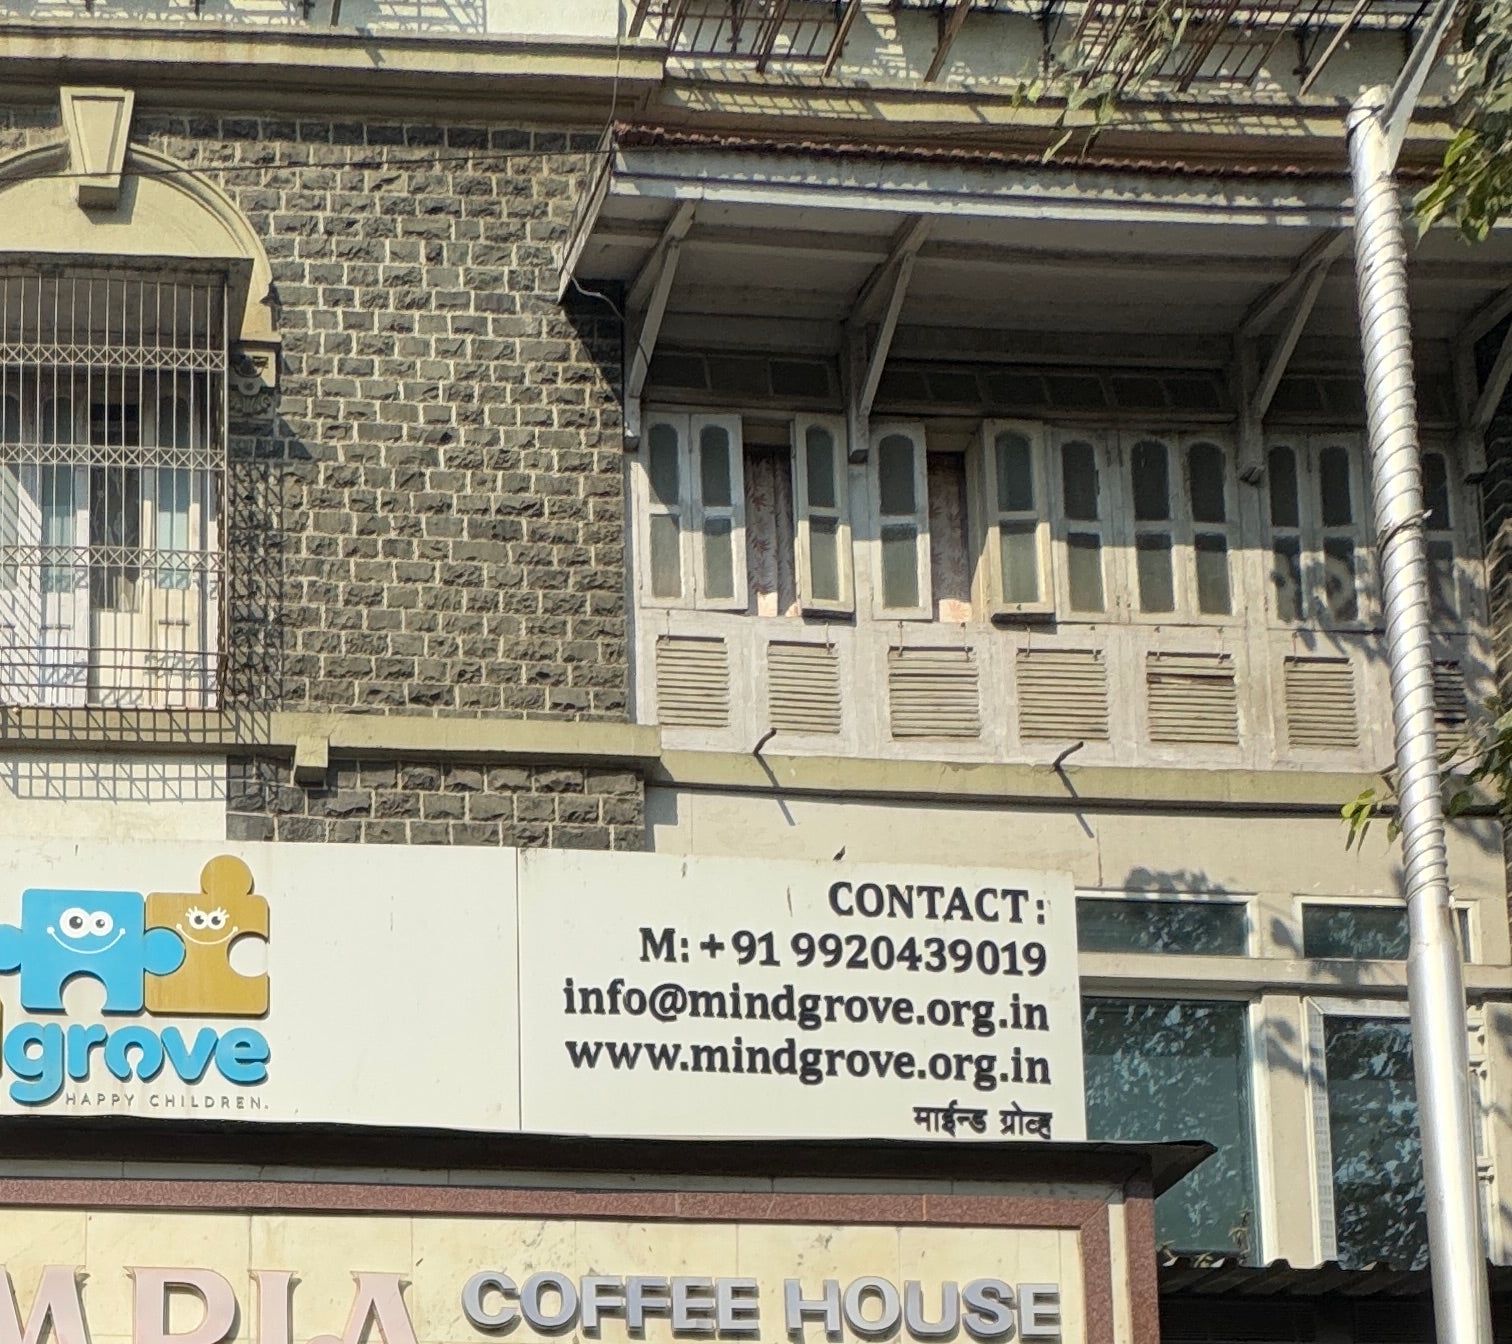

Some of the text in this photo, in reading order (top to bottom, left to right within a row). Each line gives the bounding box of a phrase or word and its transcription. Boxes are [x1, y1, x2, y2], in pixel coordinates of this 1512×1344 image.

[828, 882, 1046, 924] CONTACT:
[791, 932, 1046, 976] 9920439019
[563, 978, 1049, 1037] info@mindgrove.org.in
[565, 1037, 1052, 1091] www.mindgrove.org.in
[65, 1091, 135, 1108] HAPPY
[149, 1094, 270, 1111] CHILDREN.
[462, 1270, 1062, 1344] COFFEE HOUSE
